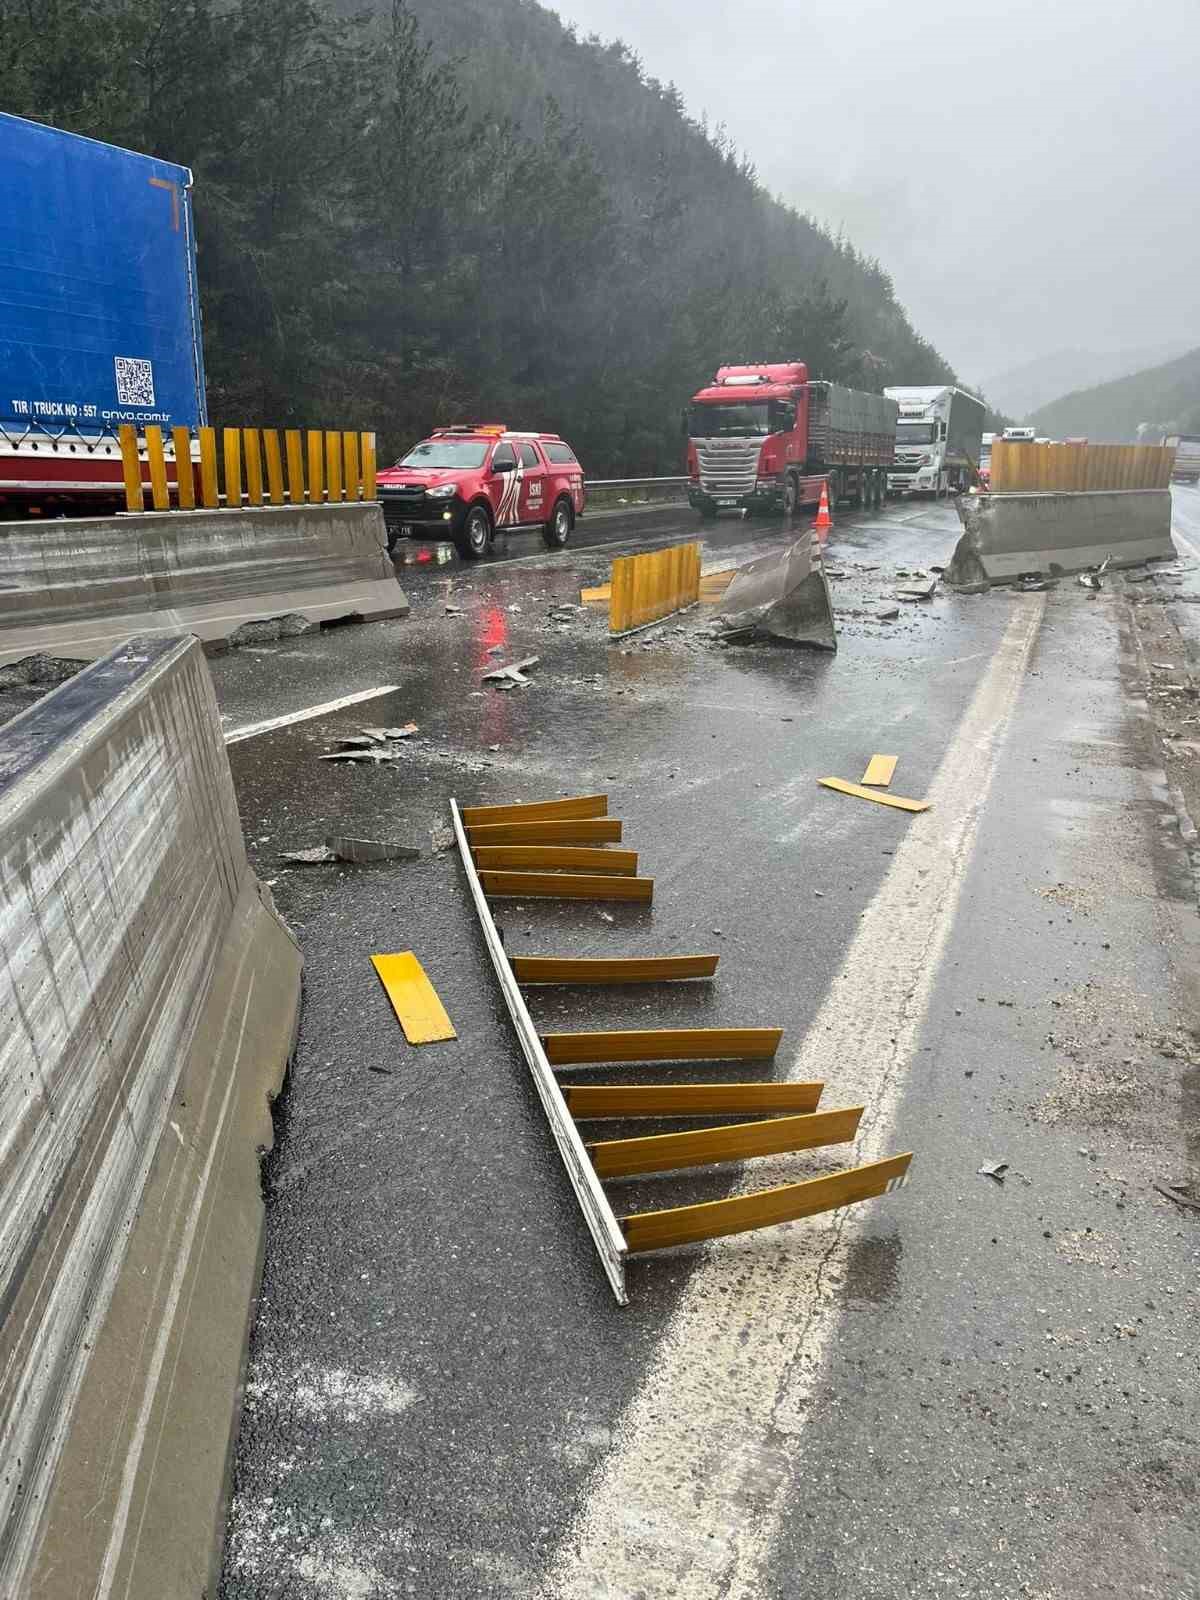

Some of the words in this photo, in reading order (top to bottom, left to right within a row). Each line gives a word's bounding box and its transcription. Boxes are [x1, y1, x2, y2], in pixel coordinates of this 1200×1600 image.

[12, 400, 28, 414] TIR
[34, 401, 63, 416] TRUCK
[65, 403, 77, 416] NO
[83, 405, 97, 417] 557
